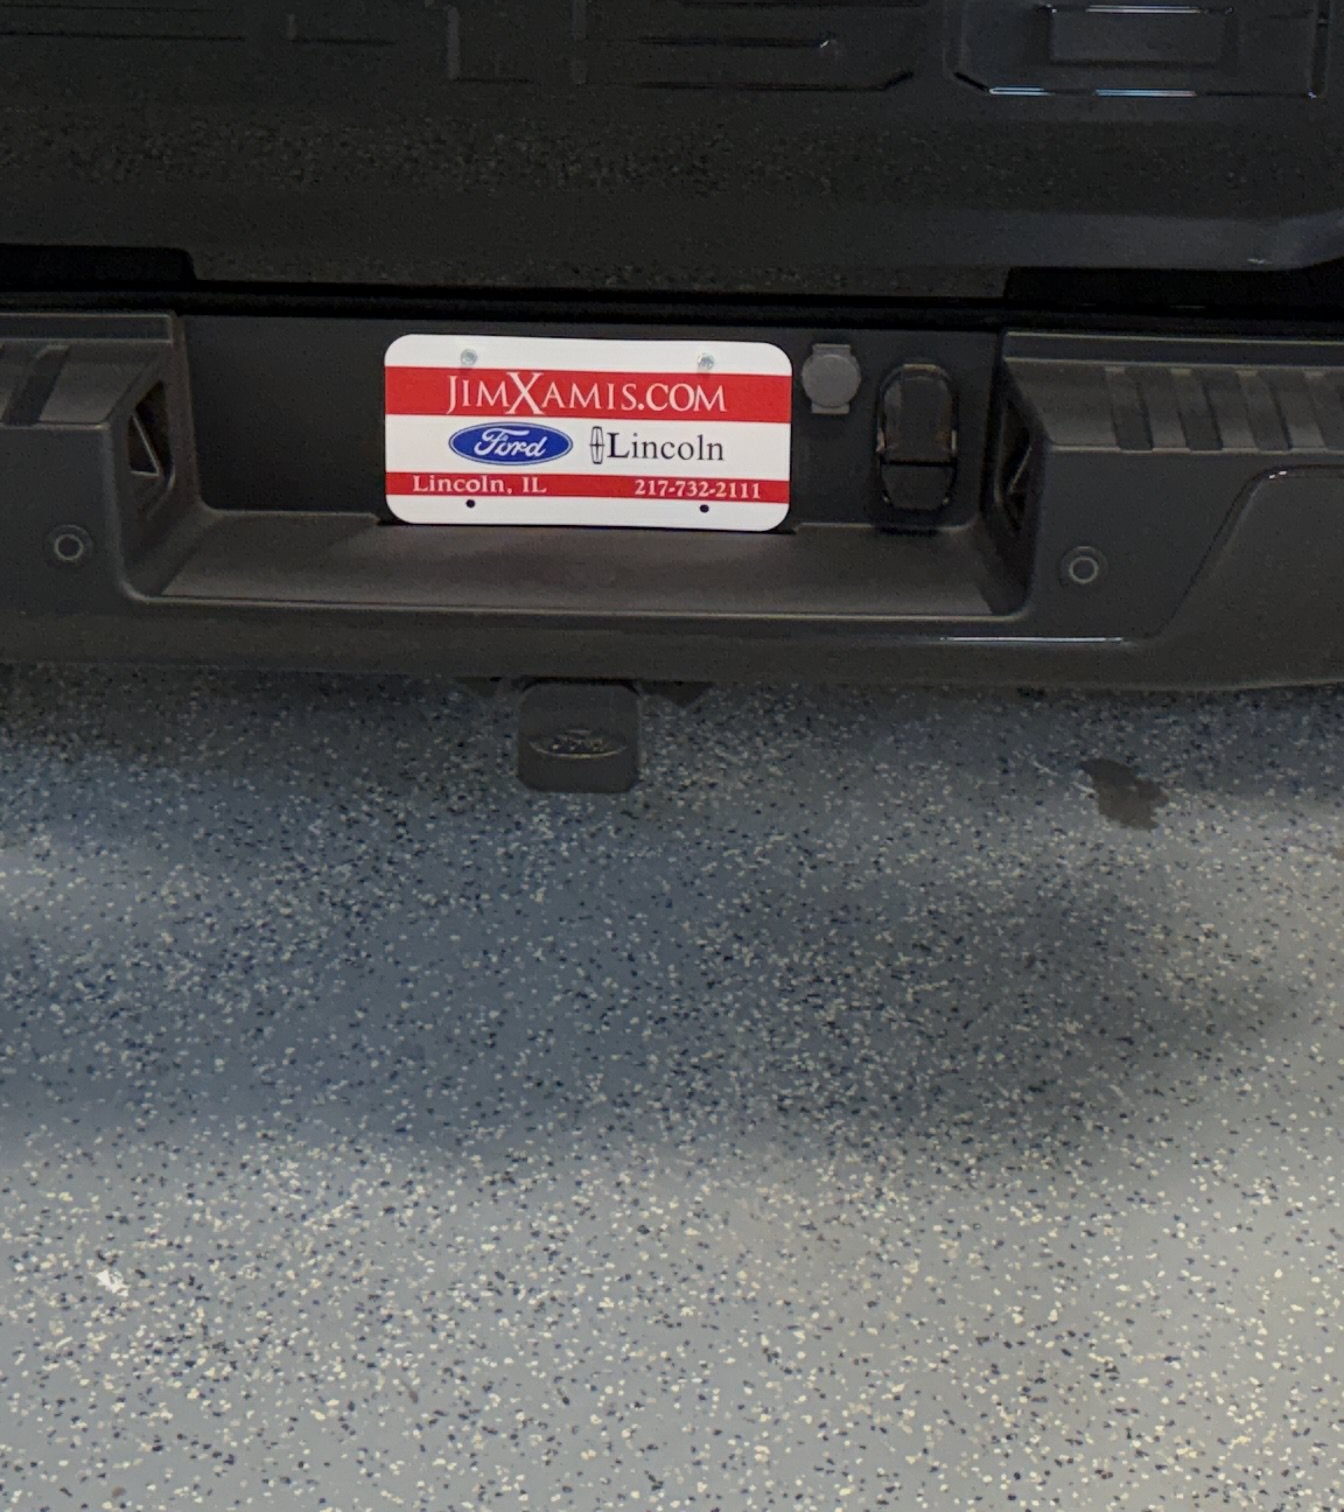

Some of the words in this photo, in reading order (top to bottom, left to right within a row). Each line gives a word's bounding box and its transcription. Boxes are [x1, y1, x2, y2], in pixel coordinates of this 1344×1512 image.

[445, 372, 727, 415] JIMXAMIS.COM
[473, 426, 548, 458] Ford
[607, 432, 725, 462] Lincoln
[522, 476, 548, 494] IL
[634, 478, 761, 500] 217-732-2111
